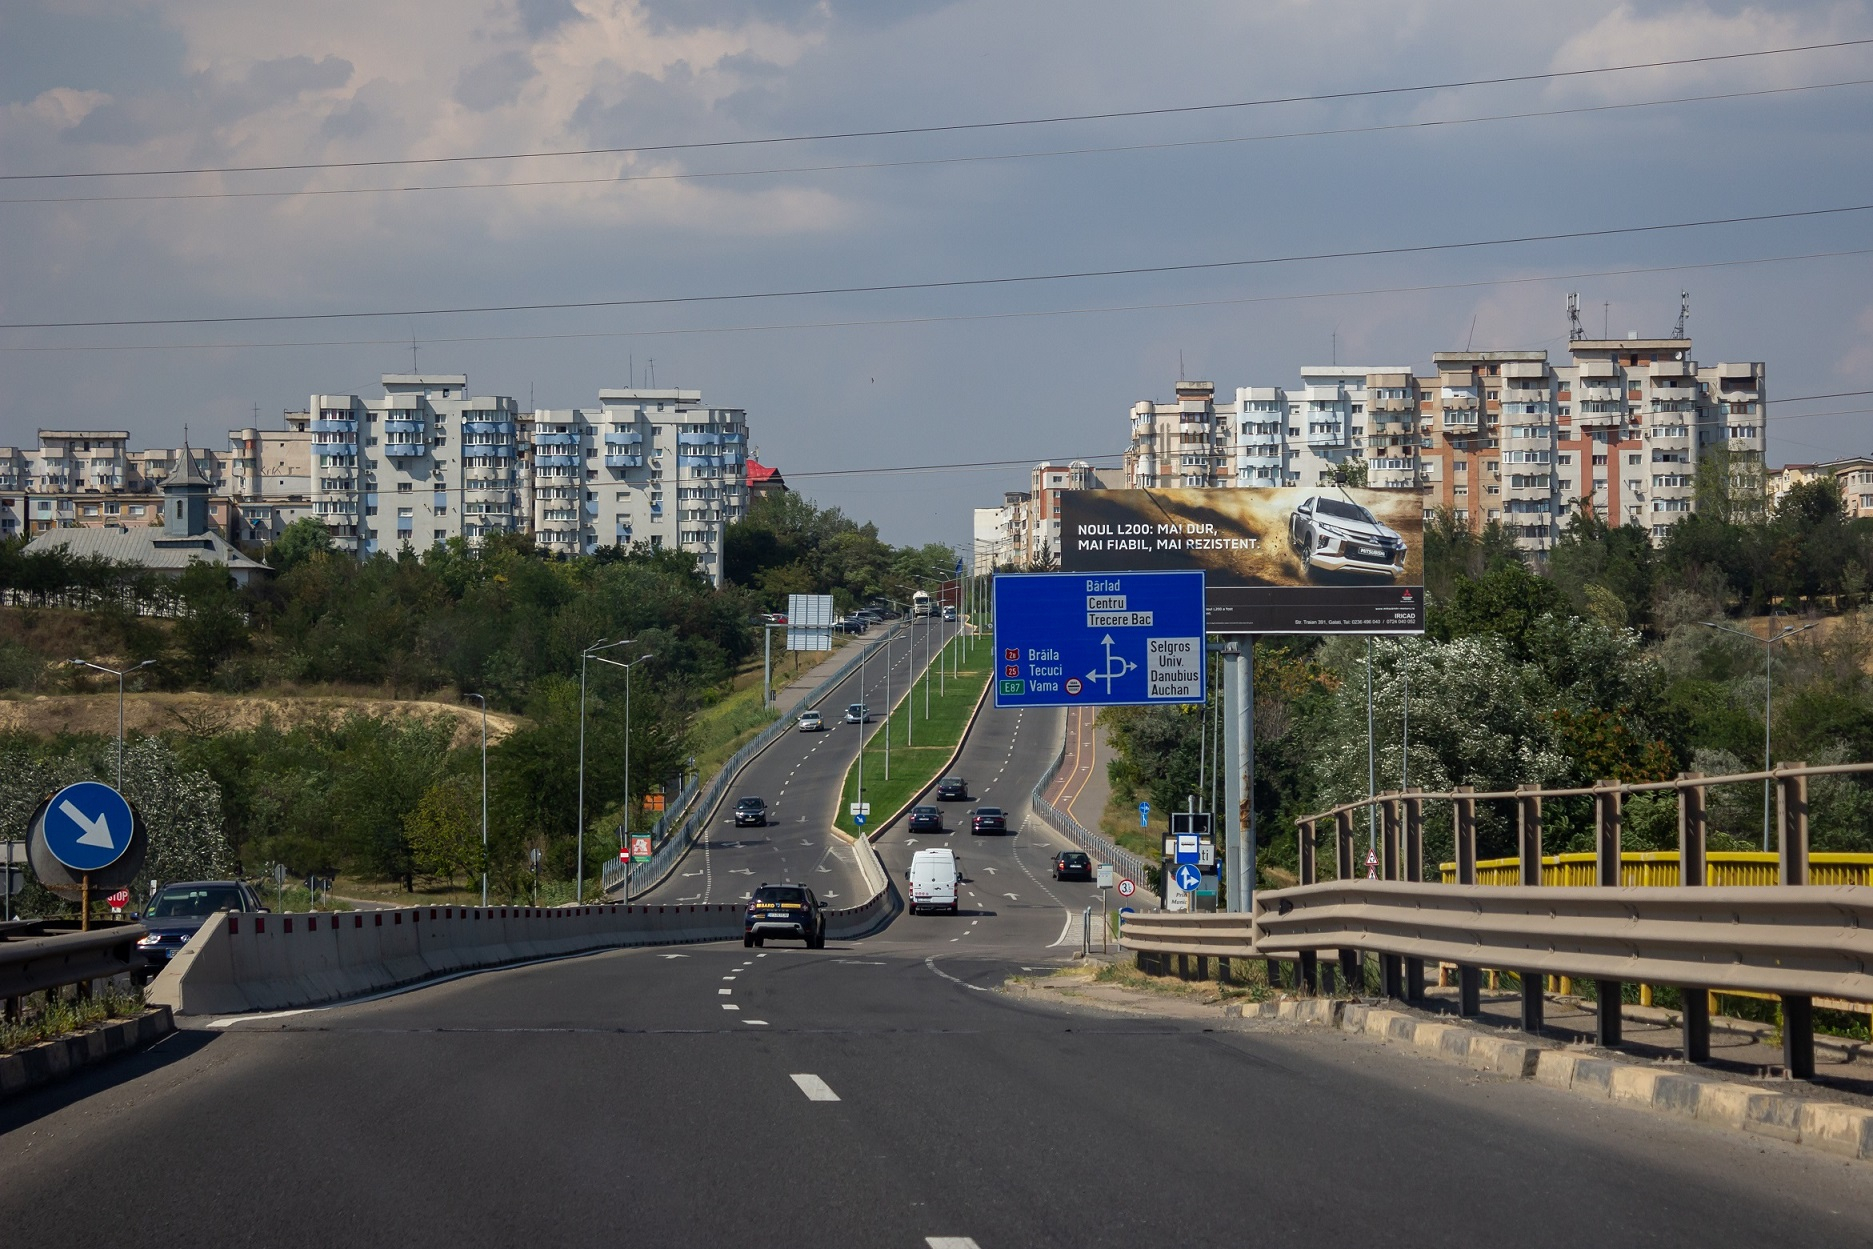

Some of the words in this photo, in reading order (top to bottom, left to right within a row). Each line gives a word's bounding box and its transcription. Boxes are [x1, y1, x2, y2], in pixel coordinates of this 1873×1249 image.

[1078, 524, 1113, 535] NOUL
[1117, 524, 1153, 535] L200:
[1158, 524, 1182, 534] MAI
[1186, 524, 1218, 536] DUR,
[1078, 540, 1103, 550] MAI
[1107, 539, 1152, 552] FIABIL,
[1156, 539, 1182, 550] MAI
[1186, 538, 1260, 550] REZISTENT.
[1088, 597, 1124, 609] Centru
[1088, 613, 1128, 626] Trecere
[1131, 612, 1152, 625] Bac
[1150, 640, 1190, 656] Selgros
[1159, 655, 1184, 667] Univ.
[1029, 664, 1062, 676] Tecuci
[1150, 670, 1199, 682] Danubius
[1004, 682, 1020, 692] E87
[1029, 680, 1058, 692] Vama
[1151, 684, 1189, 696] Auchan
